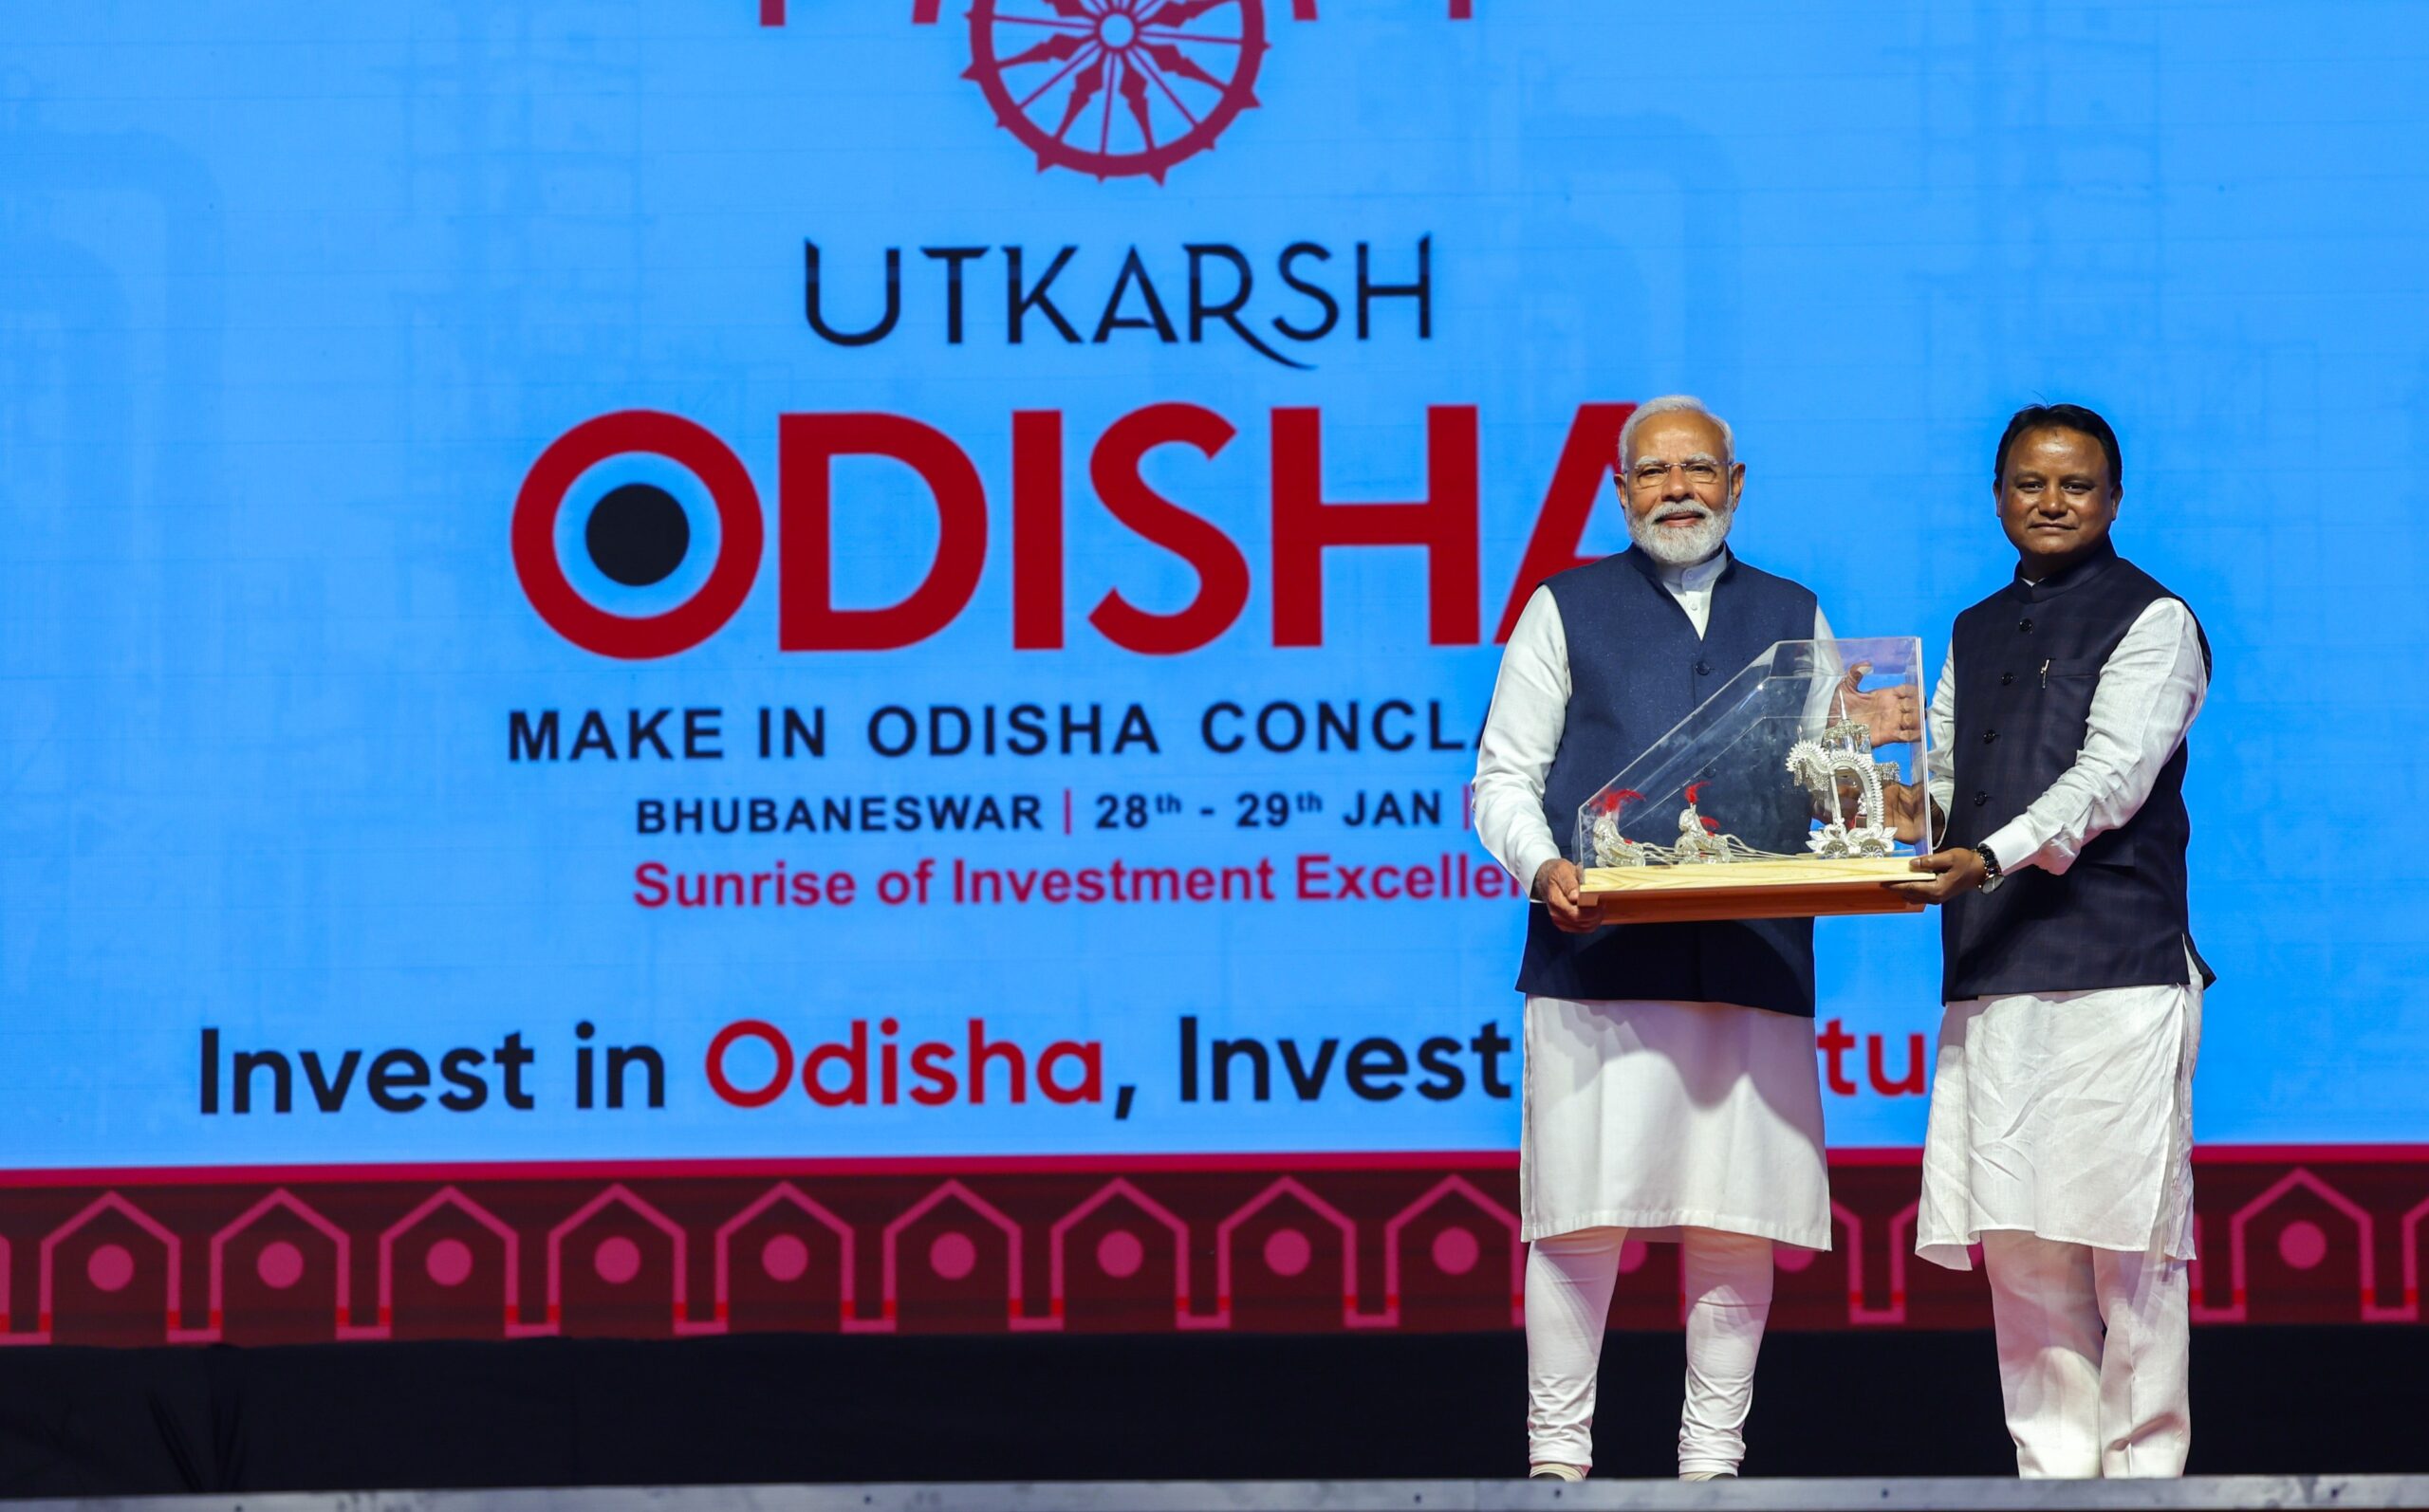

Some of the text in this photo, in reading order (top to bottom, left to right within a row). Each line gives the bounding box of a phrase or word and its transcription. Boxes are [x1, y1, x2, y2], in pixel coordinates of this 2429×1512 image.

[805, 236, 1432, 368] UTKARSH
[509, 698, 1492, 762] MAKE IN ODISHA CONCL
[637, 795, 1041, 835] BHUBANESWAR
[1096, 794, 1181, 829] 28th
[1236, 792, 1322, 827] 29th
[1344, 791, 1440, 827] JAN
[634, 861, 856, 908] Sunrise
[877, 858, 935, 906] of
[954, 857, 1275, 904] Investment
[201, 1016, 1512, 1119] Invest in Odisha, Invest
